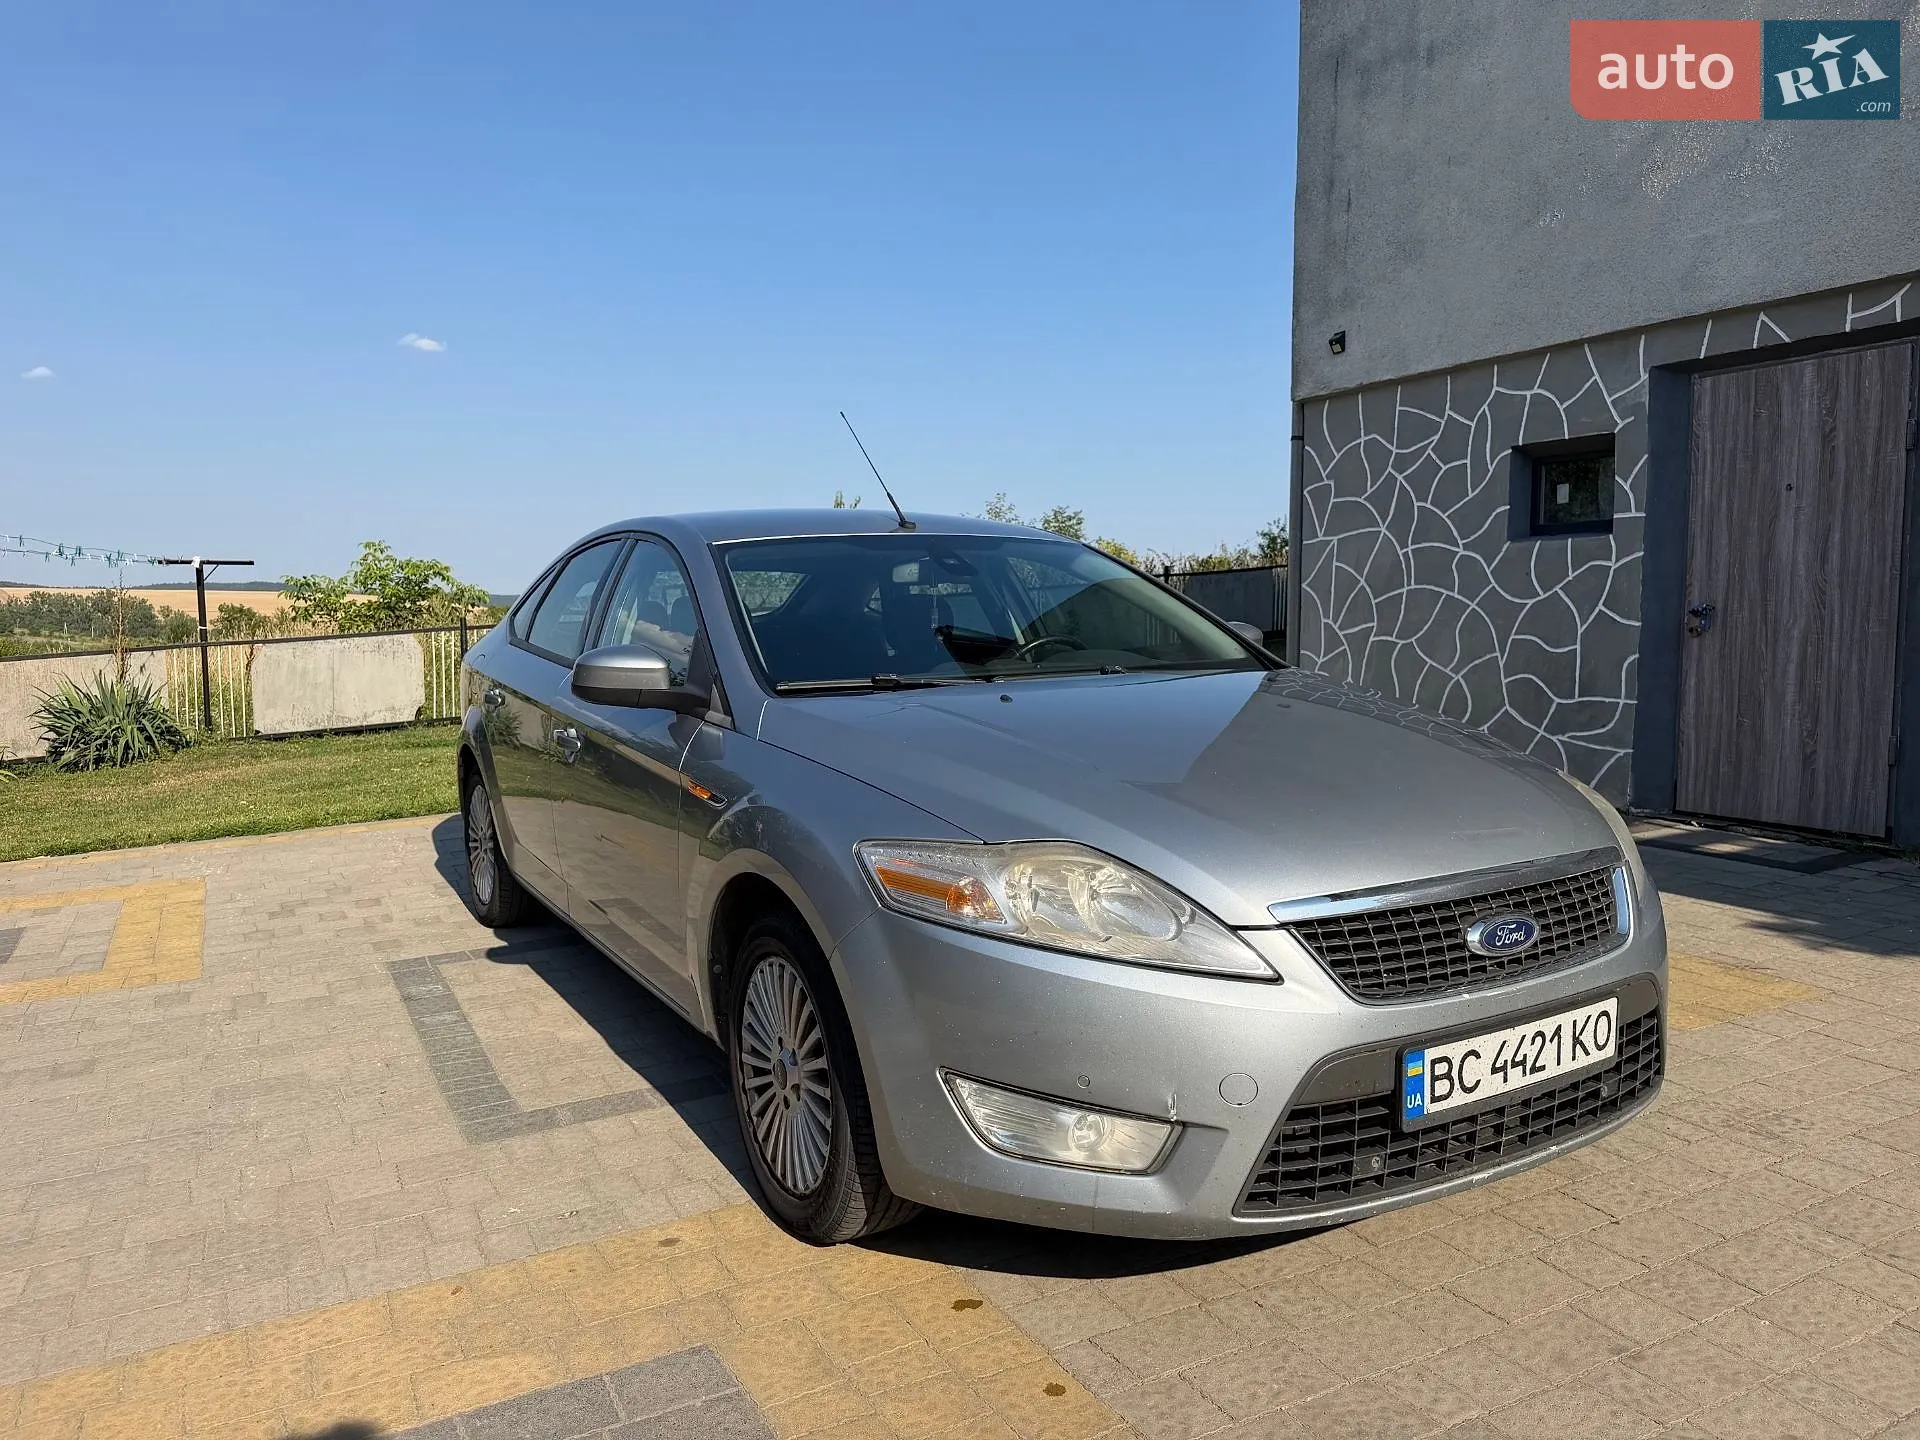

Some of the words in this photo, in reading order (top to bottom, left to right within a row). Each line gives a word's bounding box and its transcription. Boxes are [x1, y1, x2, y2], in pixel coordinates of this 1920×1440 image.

[1495, 923, 1527, 946] Ford
[1429, 1049, 1482, 1104] BC
[1490, 1023, 1562, 1084] 4421
[1571, 1009, 1612, 1062] KO
[1406, 1092, 1423, 1109] UA
